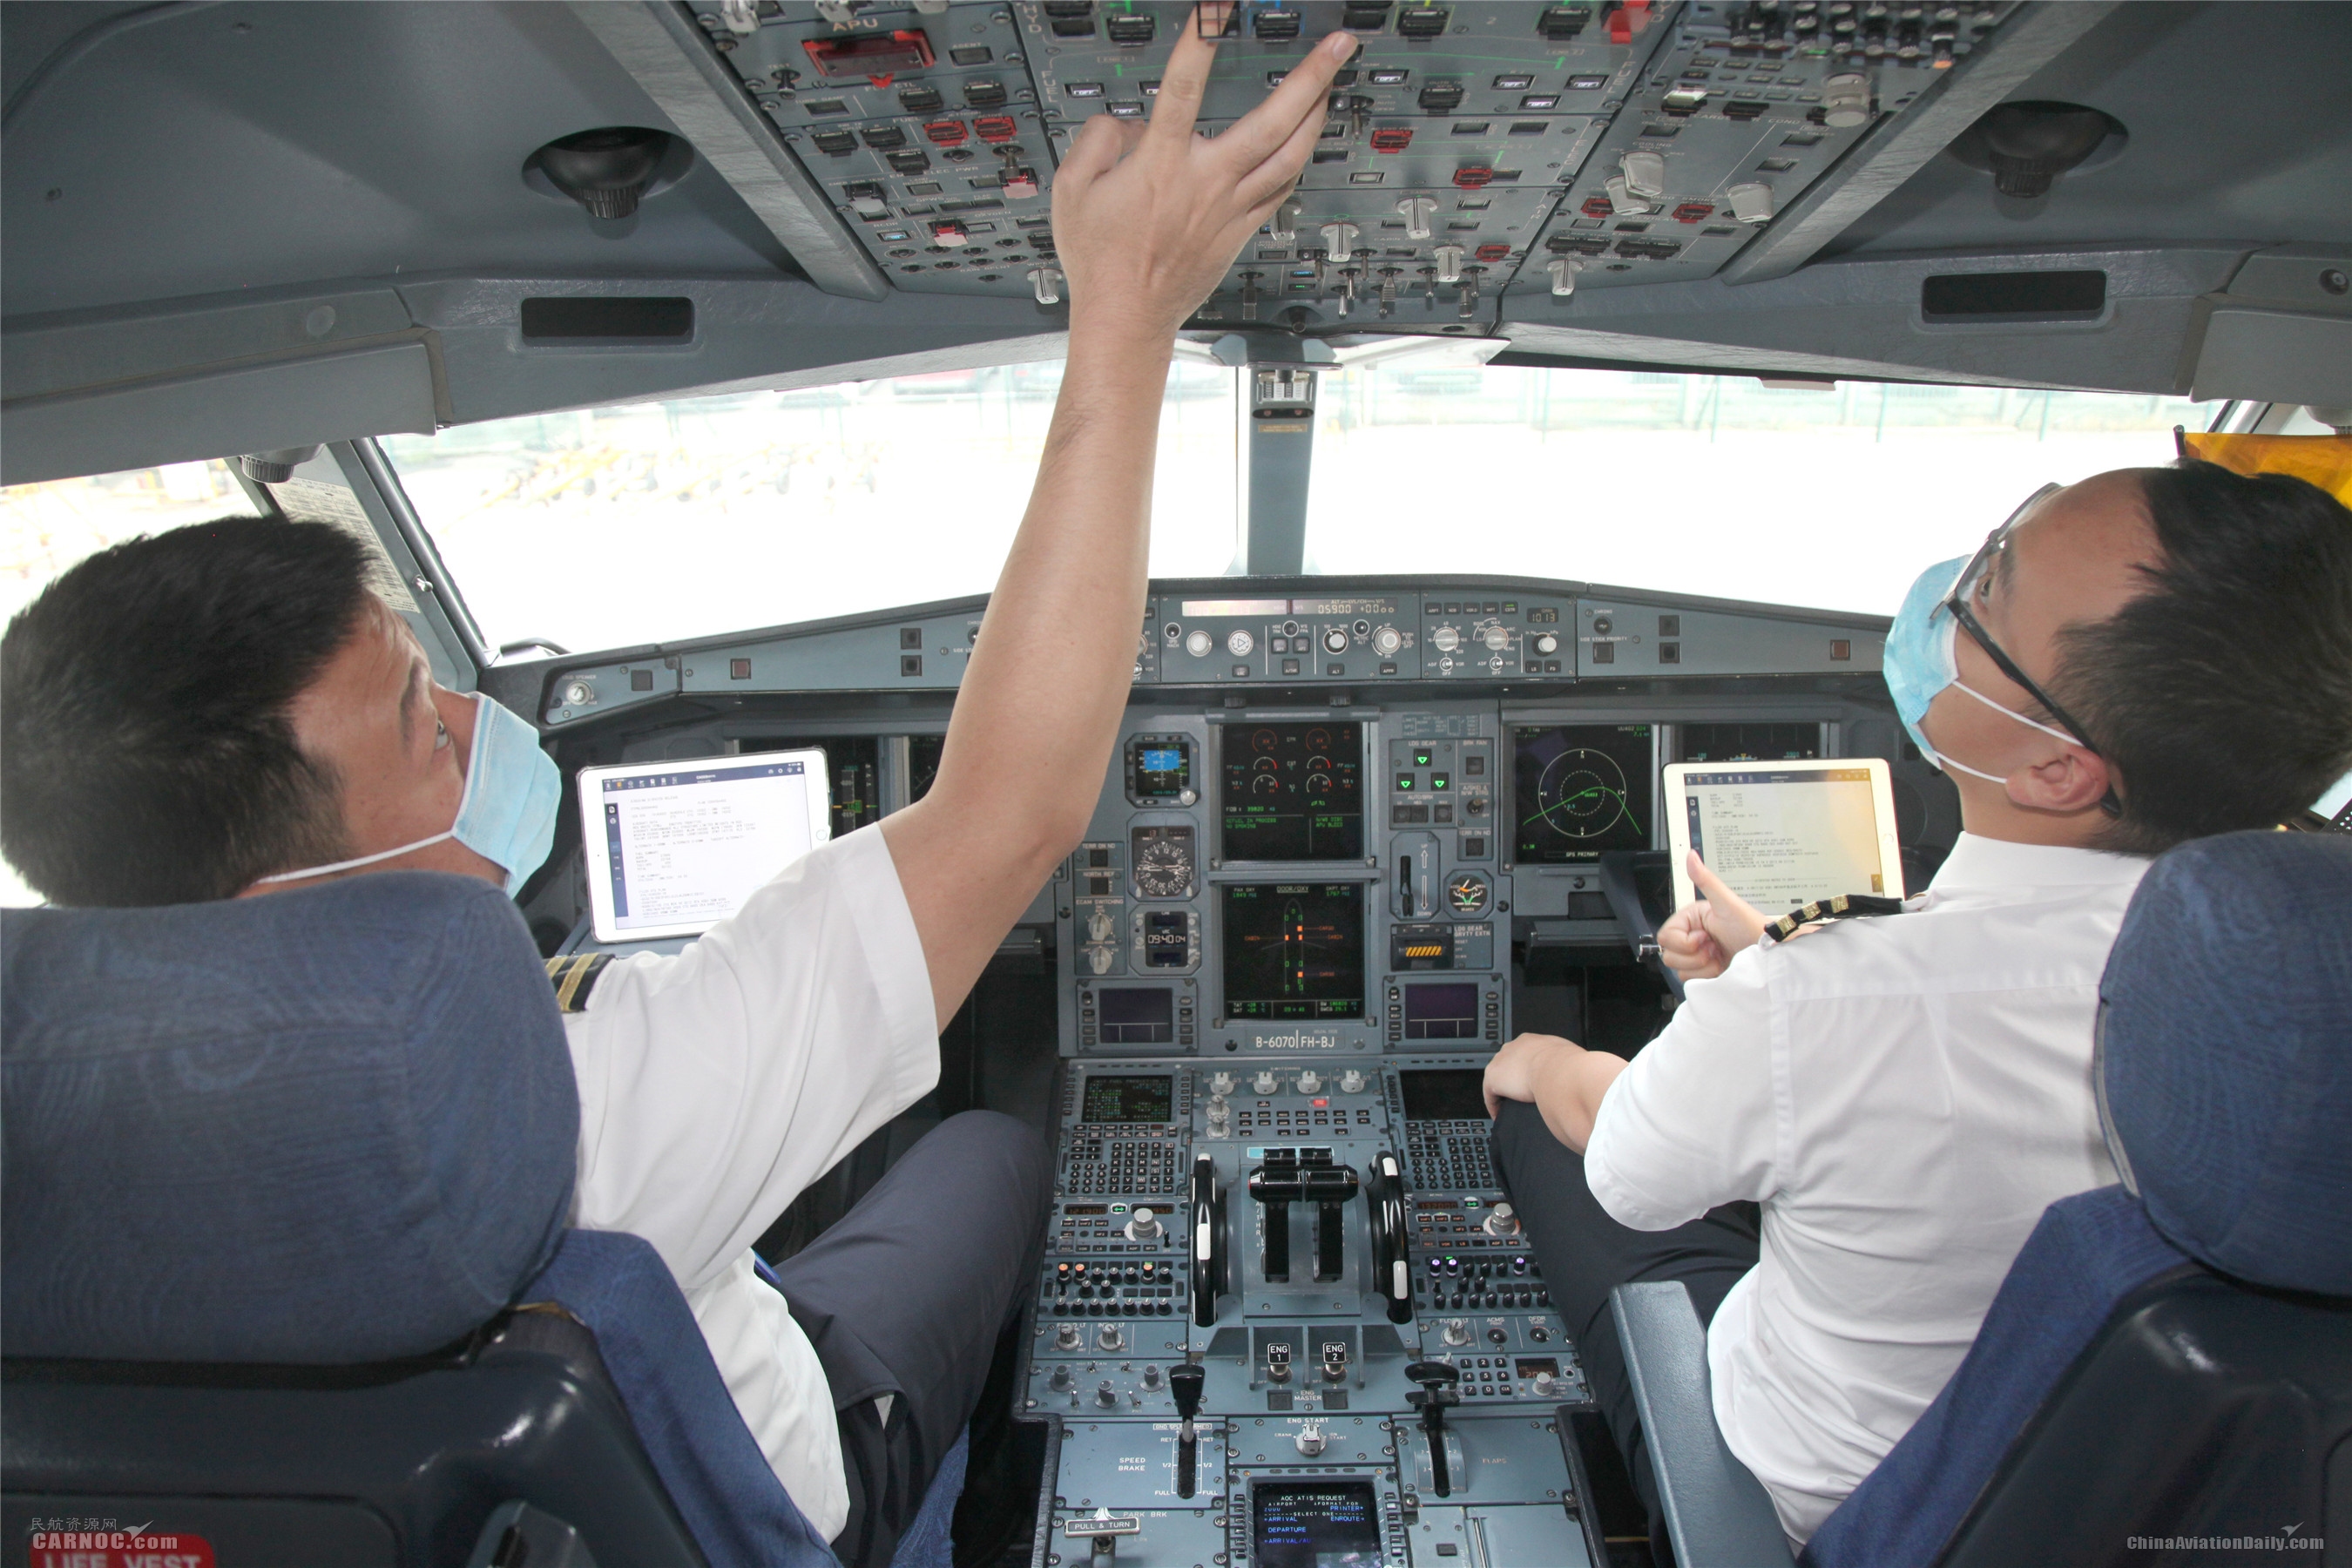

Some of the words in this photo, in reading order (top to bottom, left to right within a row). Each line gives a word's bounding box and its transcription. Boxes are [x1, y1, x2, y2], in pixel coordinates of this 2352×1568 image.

[833, 18, 878, 31] APU
[1532, 613, 1555, 622] 1013
[1148, 935, 1173, 943] 09:40
[1256, 1037, 1294, 1047] B-6070
[1301, 1037, 1335, 1048] FH-BJ
